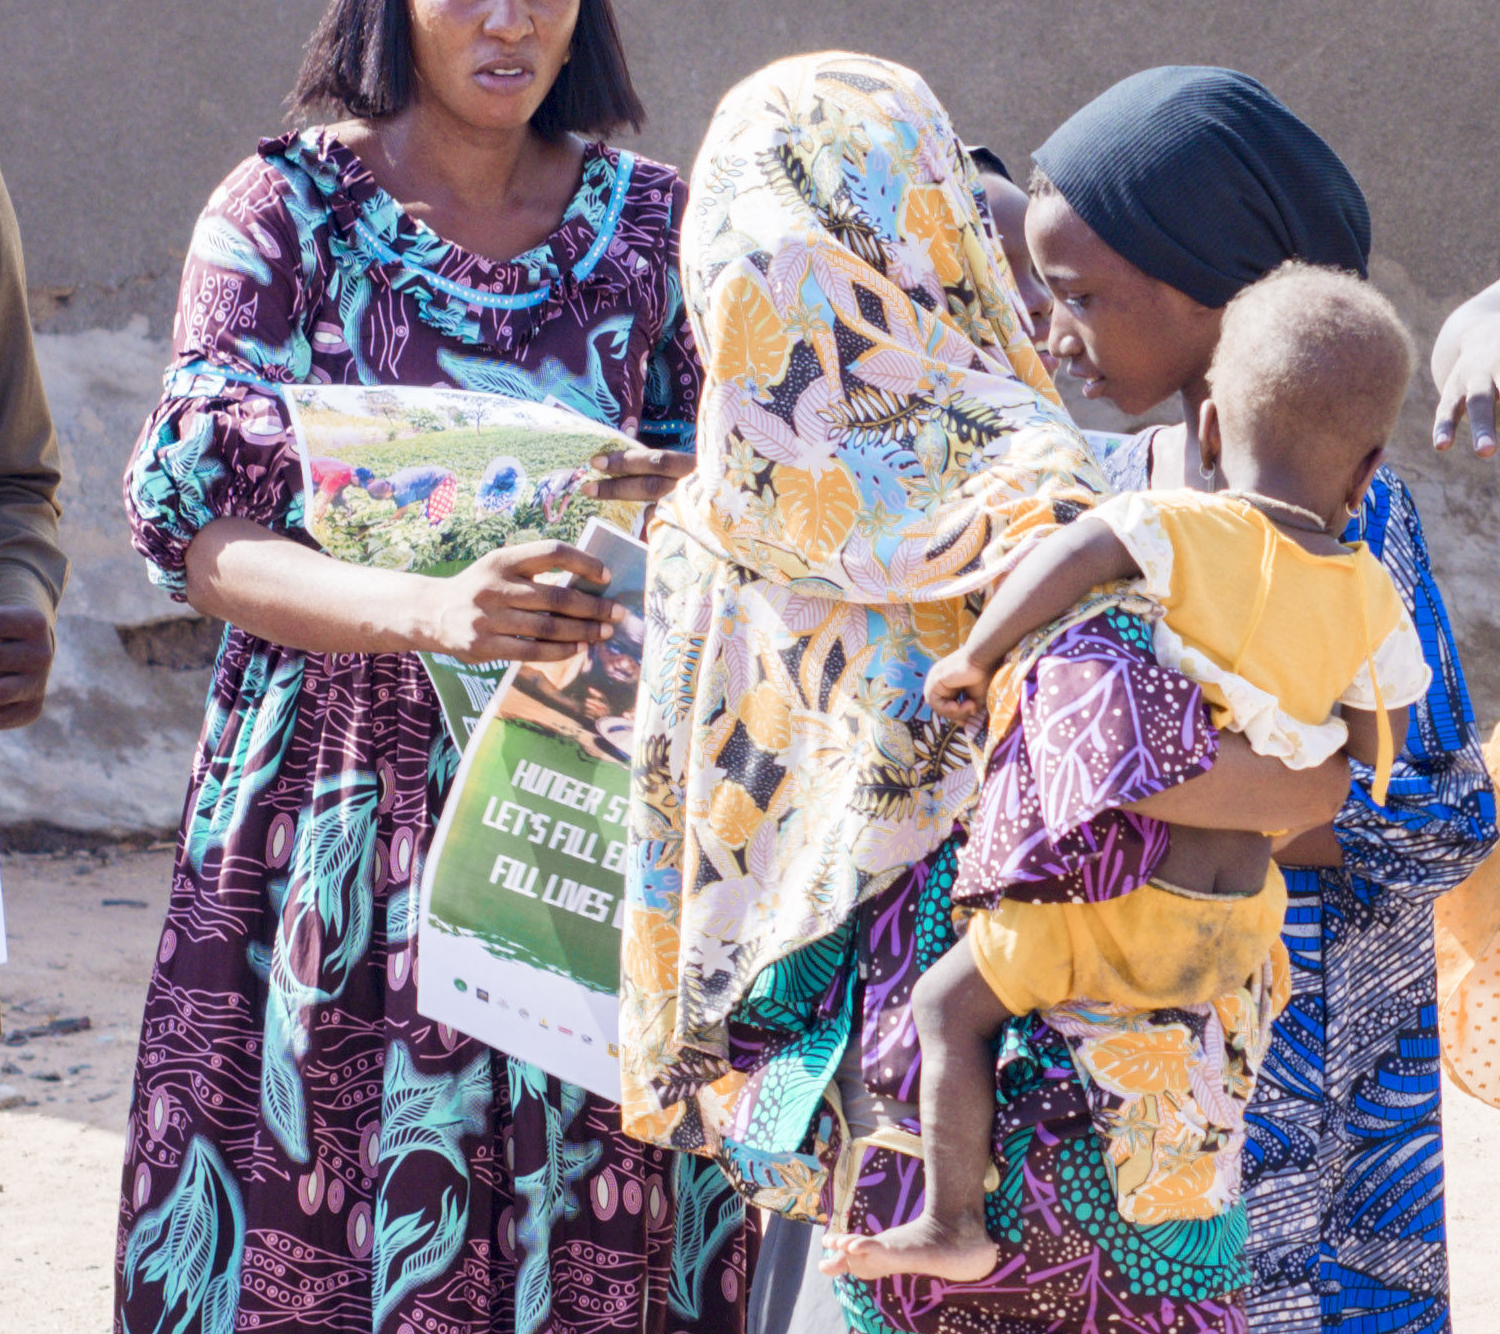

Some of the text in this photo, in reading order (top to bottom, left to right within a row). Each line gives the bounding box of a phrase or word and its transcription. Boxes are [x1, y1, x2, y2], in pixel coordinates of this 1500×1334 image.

[511, 759, 606, 816] HUNGER
[482, 796, 551, 845] LET'S
[548, 820, 598, 864] FILL
[489, 854, 539, 899] FILL
[541, 874, 614, 923] LIVES
